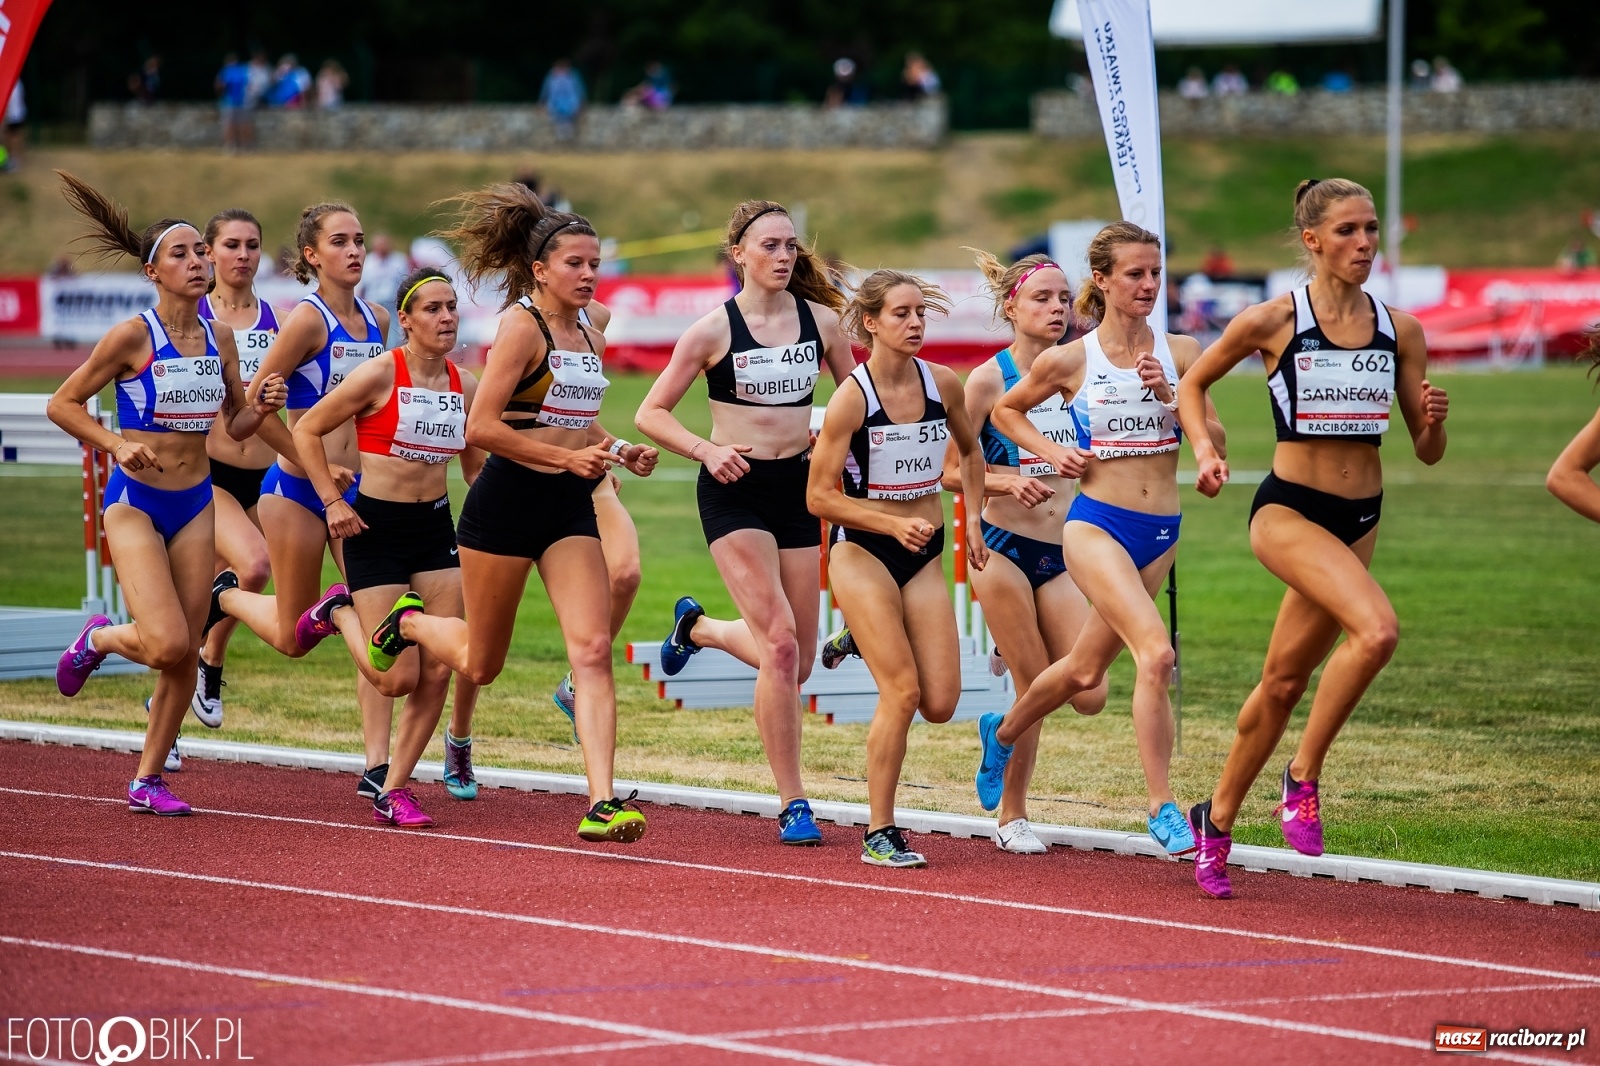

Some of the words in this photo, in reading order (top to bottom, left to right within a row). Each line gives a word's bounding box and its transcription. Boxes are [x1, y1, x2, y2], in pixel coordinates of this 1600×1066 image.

[781, 345, 815, 365] 460
[194, 359, 220, 376] 380
[1351, 354, 1390, 373] 662
[745, 376, 812, 395] DUBIELLA
[159, 386, 224, 403] JABŁOŃSKA
[1302, 387, 1389, 402] SARNECKA
[438, 395, 462, 413] 554
[162, 420, 203, 429] RACIBÓRZ
[546, 415, 582, 427] RACIBÓRZ
[1107, 416, 1166, 432] CIOŁAK
[1308, 421, 1359, 432] RACIBÓRZ
[1361, 423, 1379, 432] 2019
[414, 421, 456, 438] FIUTEK
[918, 423, 947, 443] 515
[399, 450, 439, 463] RACIBÓRZ
[1099, 448, 1148, 458] RACIBÓRZ
[895, 456, 932, 474] PYKA
[434, 496, 448, 510] NIKE
[878, 490, 922, 501] RACIBÓRZ
